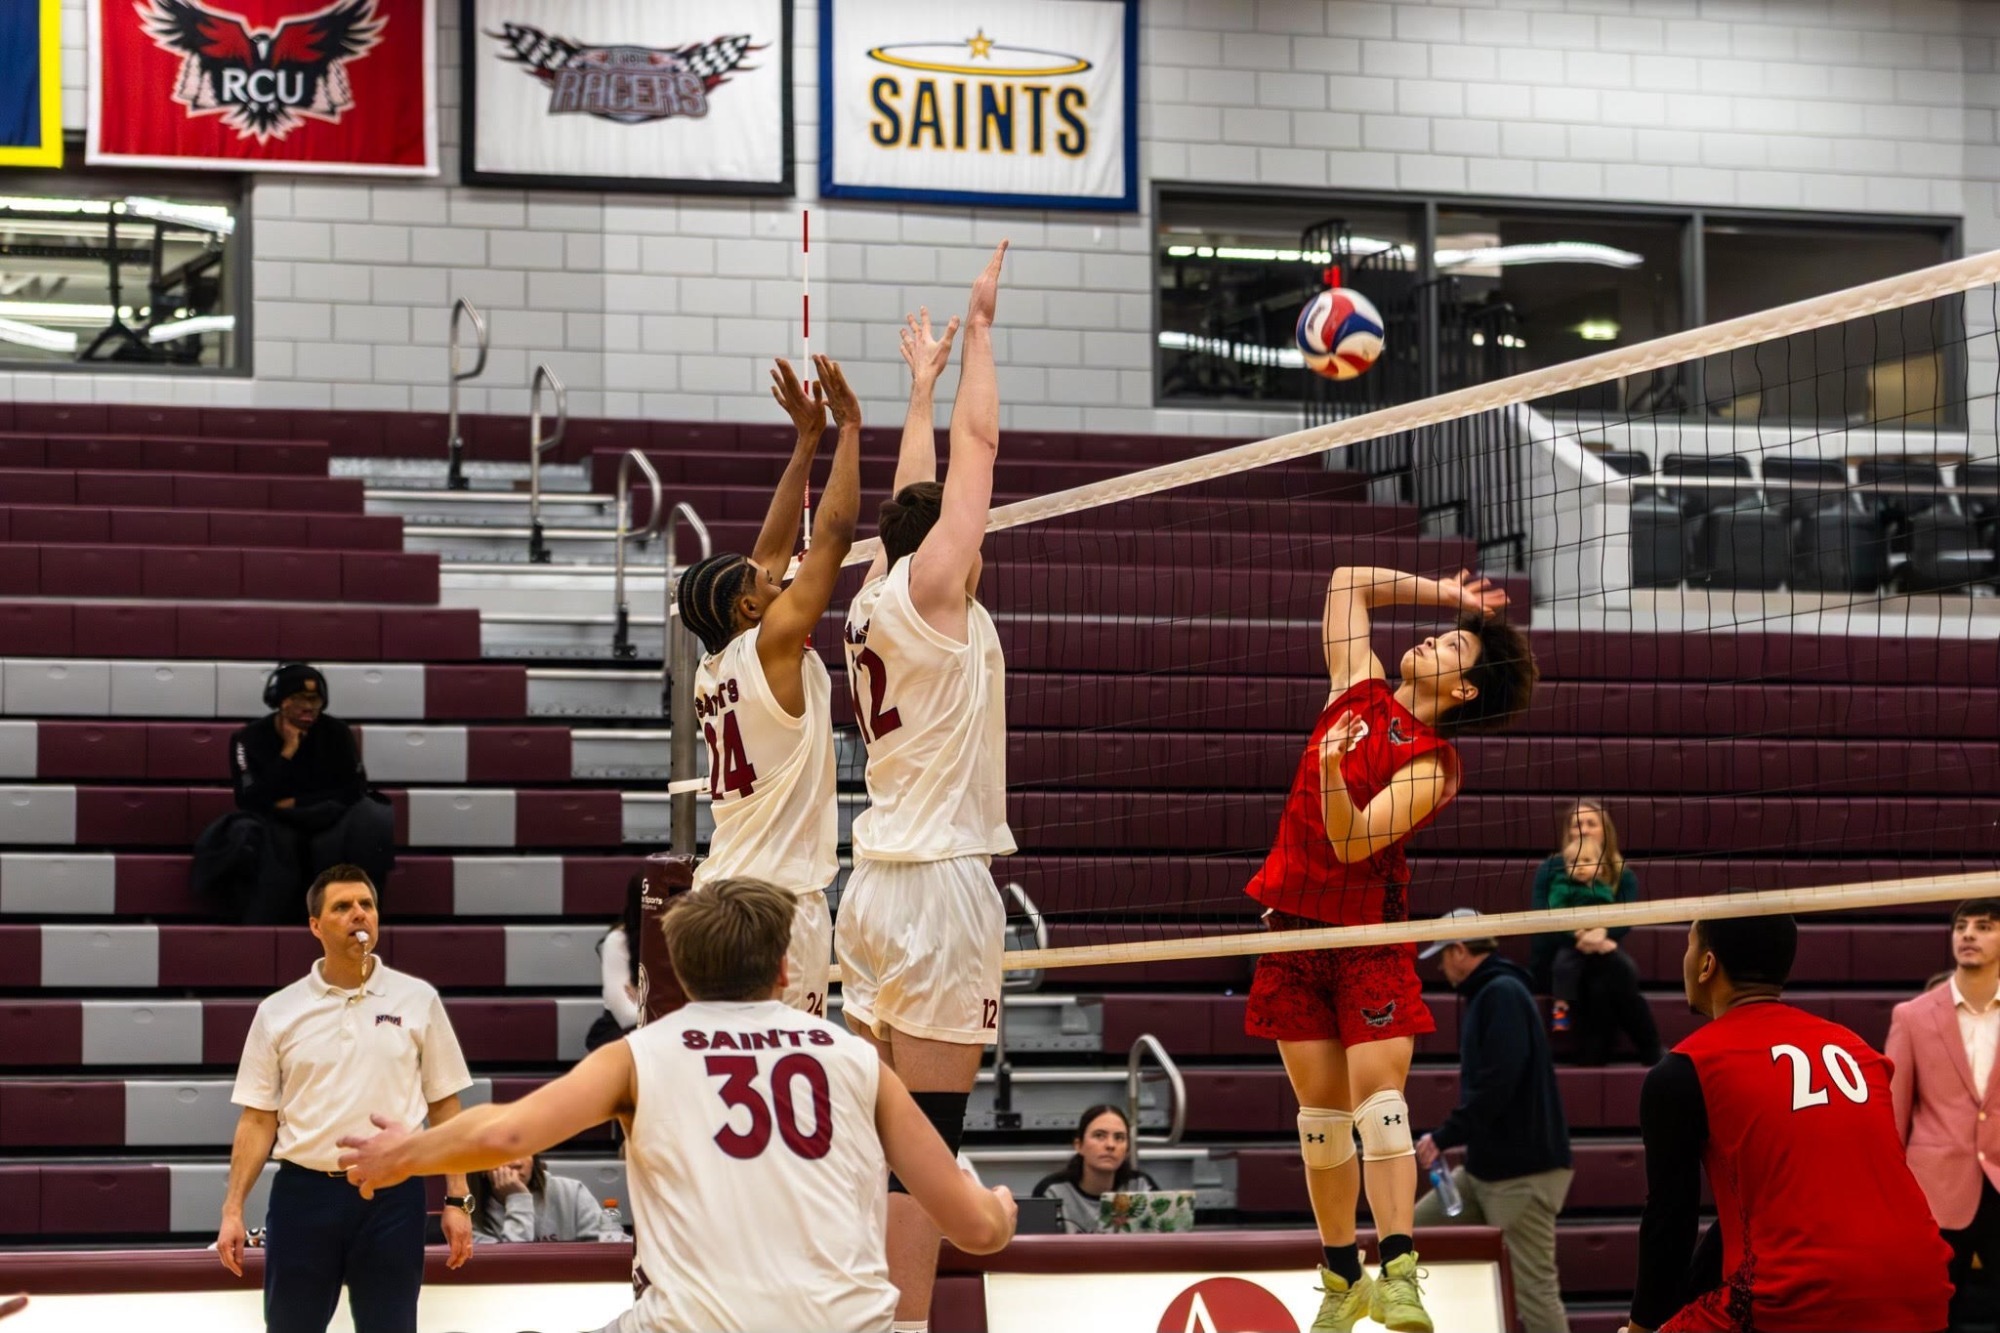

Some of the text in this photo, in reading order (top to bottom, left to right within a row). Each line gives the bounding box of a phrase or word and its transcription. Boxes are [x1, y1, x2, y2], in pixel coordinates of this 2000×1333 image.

[222, 67, 305, 104] RCU
[549, 69, 707, 119] RACERS
[869, 76, 1088, 159] SAINTS
[807, 991, 823, 1018] 24
[982, 998, 998, 1029] 12
[681, 1028, 835, 1051] SAINTS
[1769, 1043, 1869, 1112] 20
[703, 1052, 834, 1161] 30
